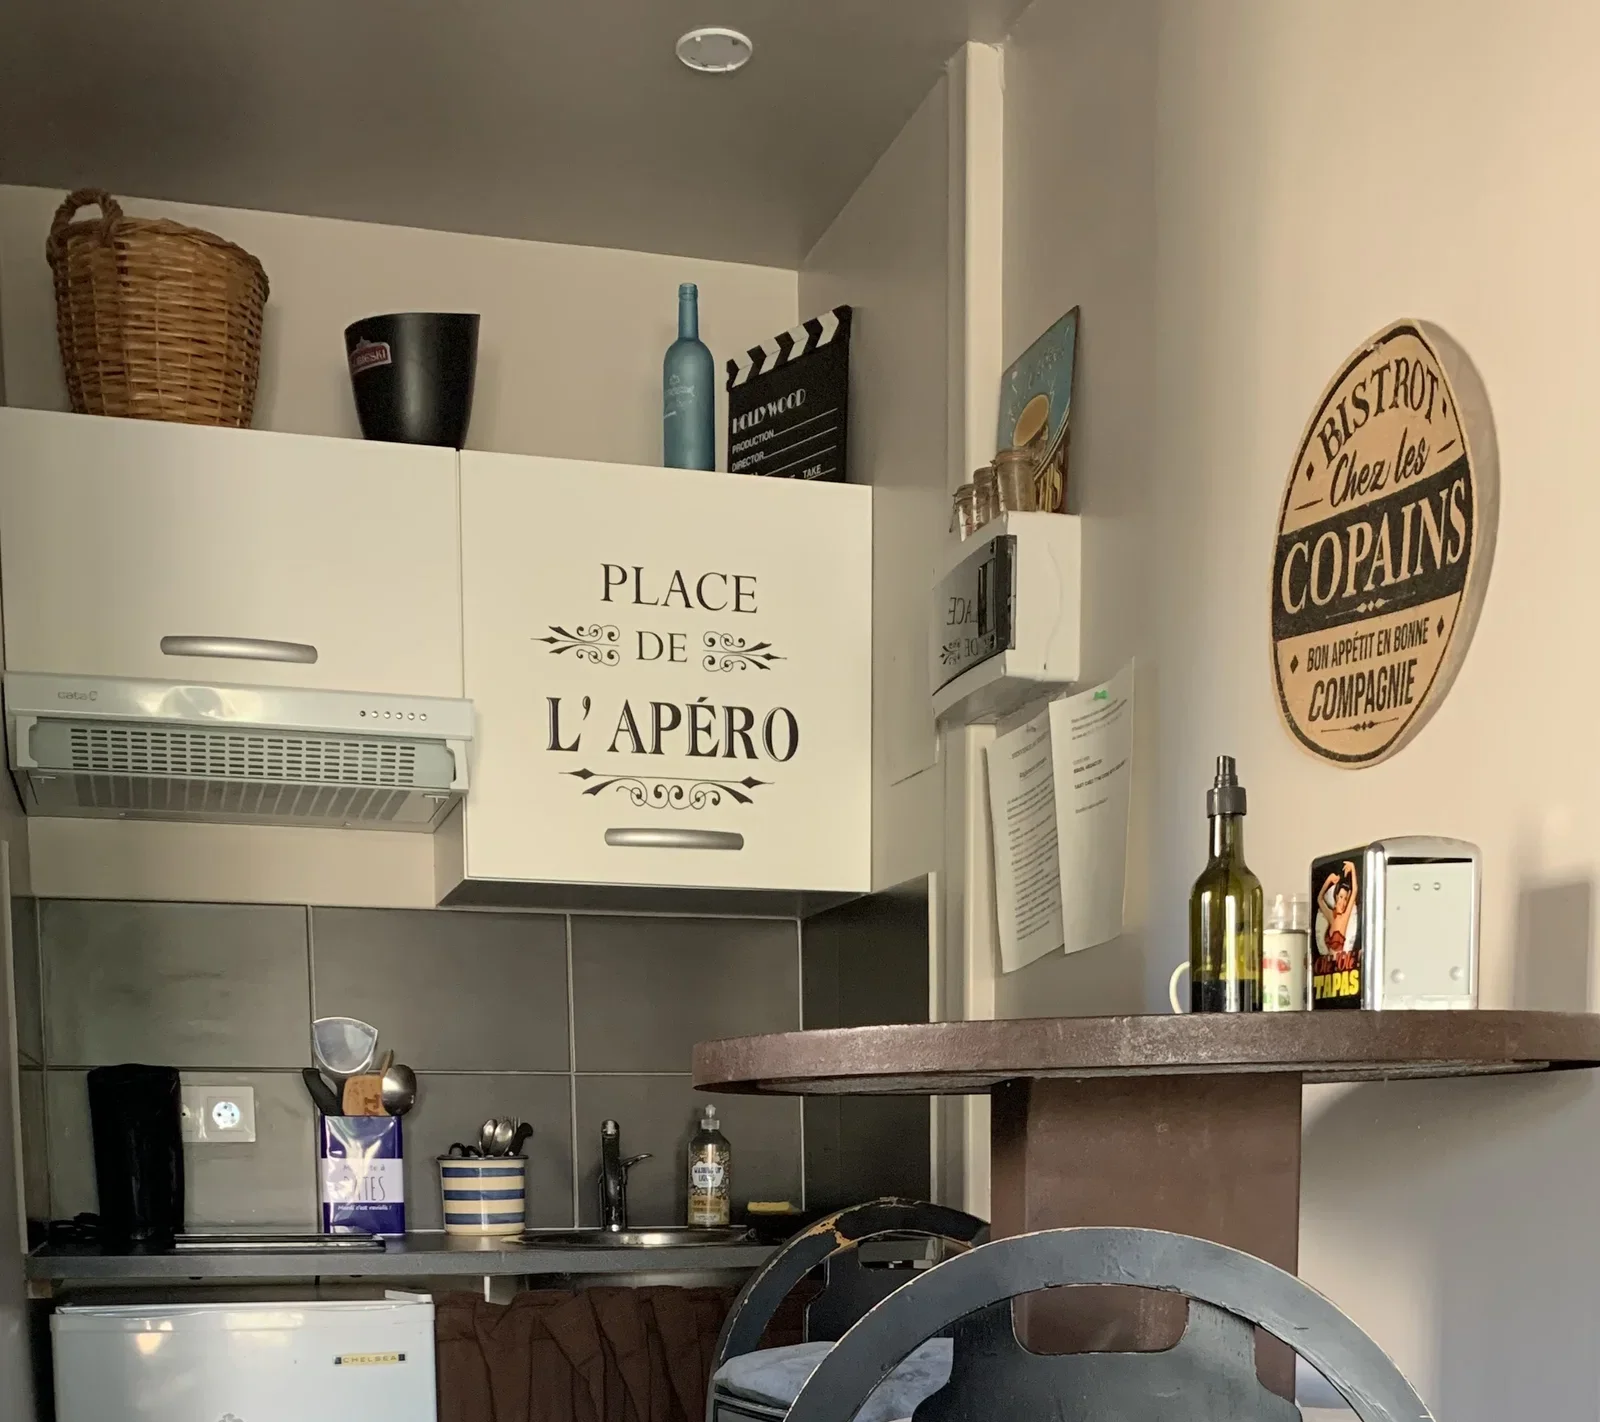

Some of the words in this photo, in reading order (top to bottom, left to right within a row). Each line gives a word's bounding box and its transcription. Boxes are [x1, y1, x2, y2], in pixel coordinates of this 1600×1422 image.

[732, 388, 806, 434] HOLLYWOOD
[1316, 357, 1439, 469] BISTROT
[731, 451, 765, 472] DIRECTOR
[732, 429, 775, 454] PRODUCTION
[802, 464, 821, 479] TAKE
[1330, 449, 1392, 508] Chez
[1394, 427, 1431, 484] les
[1280, 477, 1466, 615] COPAINS
[600, 563, 758, 614] PLACE
[635, 630, 688, 663] DE
[1306, 643, 1330, 673] BON
[1331, 631, 1375, 668] APPÉTIT
[1376, 628, 1392, 657] EN
[1394, 617, 1430, 653] BONNE
[1308, 658, 1418, 722] COMPAGNIE
[1314, 969, 1359, 999] TAPAS
[342, 1355, 397, 1364] CHELSEA
